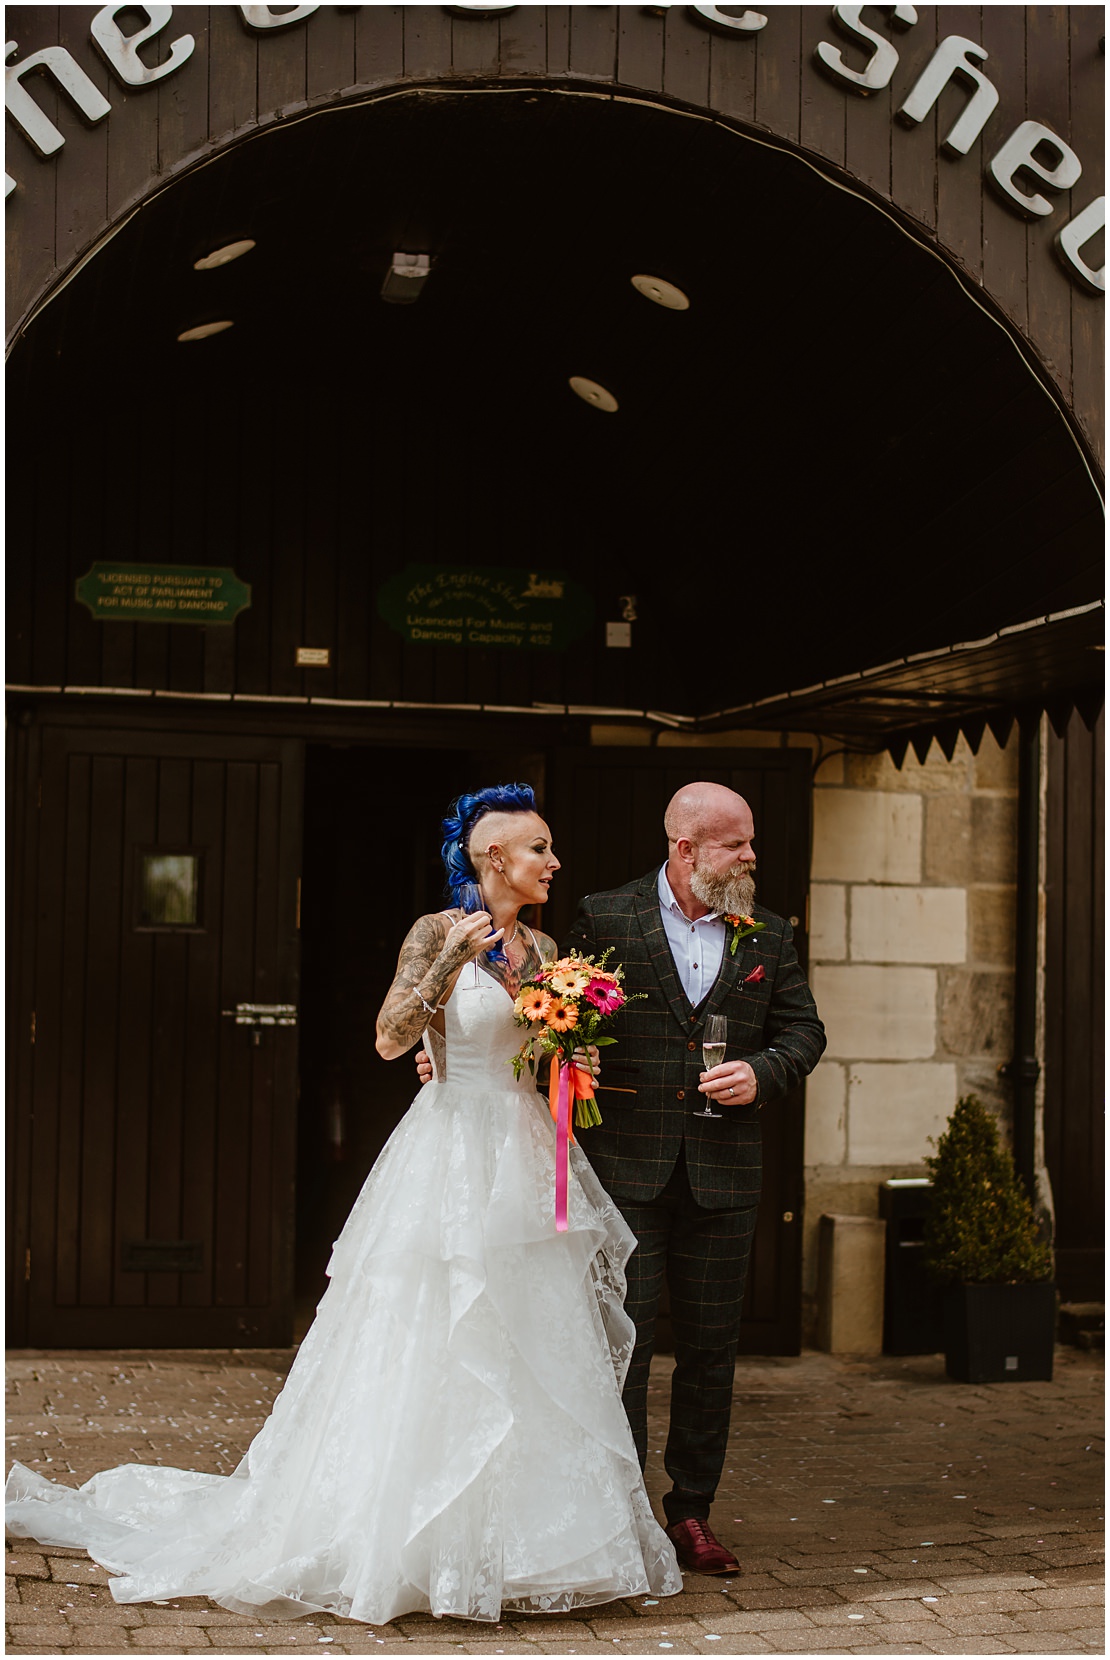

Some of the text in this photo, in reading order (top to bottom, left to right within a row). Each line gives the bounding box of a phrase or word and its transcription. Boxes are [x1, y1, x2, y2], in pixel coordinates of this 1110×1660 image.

[153, 574, 207, 587] PURSUANT
[209, 577, 223, 588] TO
[407, 582, 432, 604] The
[436, 572, 490, 589] Engine
[113, 585, 214, 599] ACT OF PARLIAMENT
[98, 596, 119, 608] FOR
[121, 597, 153, 609] MUSIC
[155, 599, 176, 609] AND
[406, 614, 553, 631] Licenced For Music and
[411, 628, 552, 646] Dancing Capacity 452
